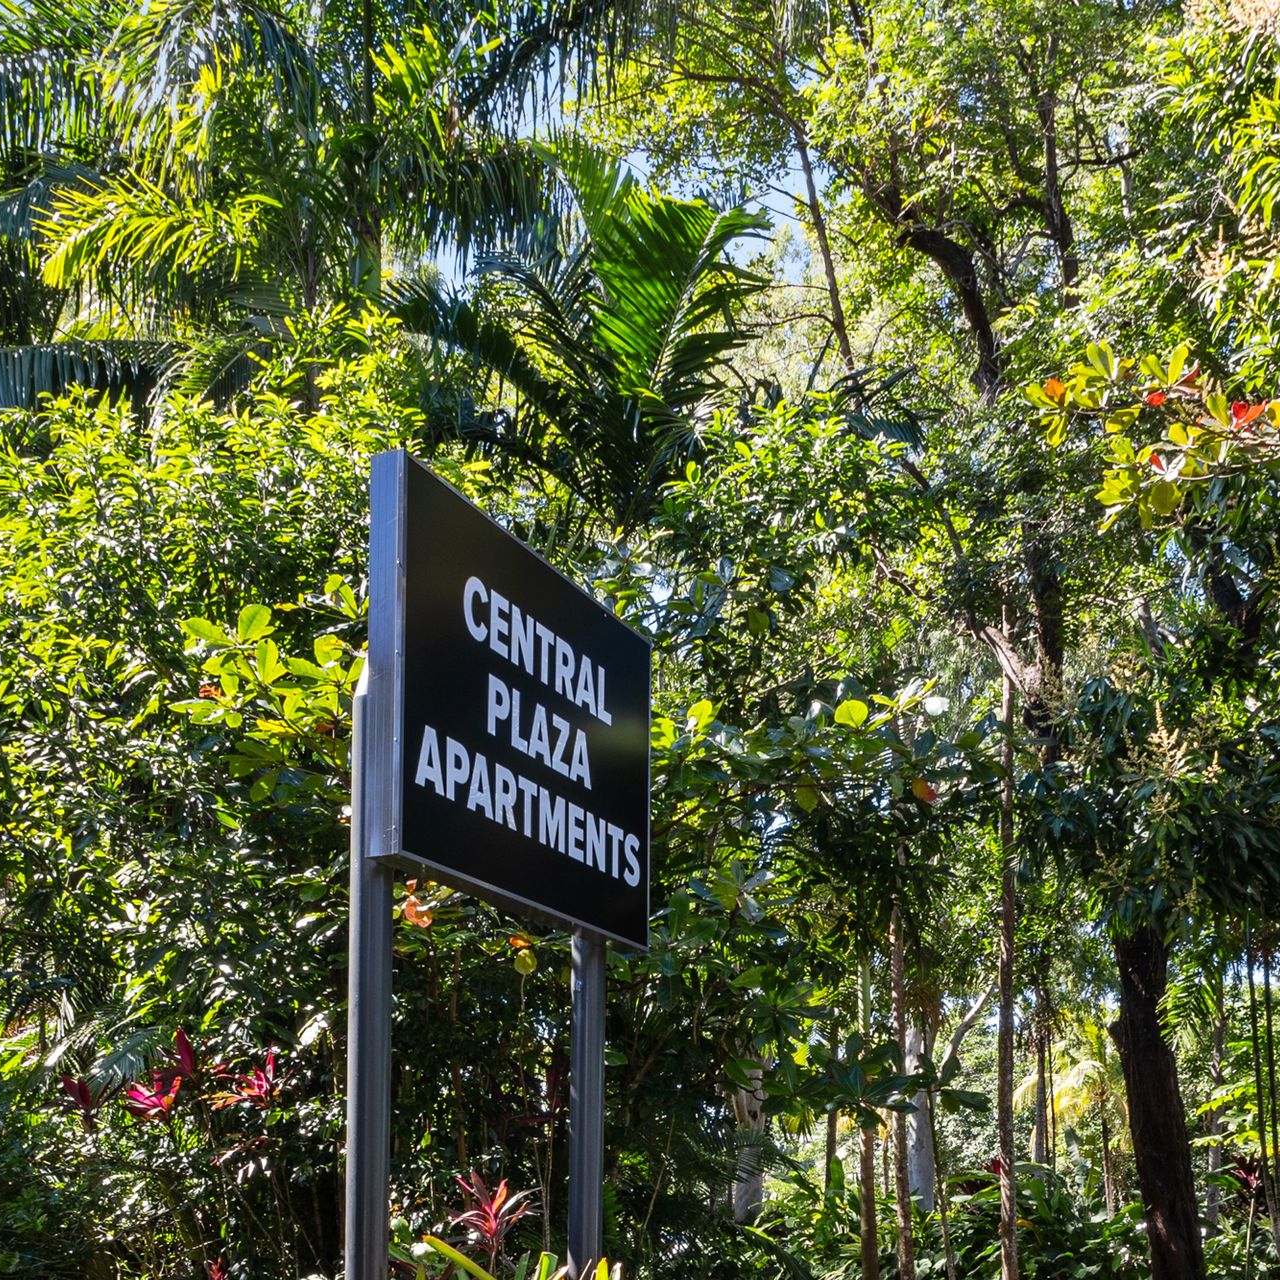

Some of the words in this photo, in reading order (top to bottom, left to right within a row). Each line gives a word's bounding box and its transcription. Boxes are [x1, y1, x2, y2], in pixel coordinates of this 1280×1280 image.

[462, 576, 612, 727] CENTRAL
[415, 725, 641, 888] APARTMENTS
[486, 673, 592, 790] PLAZA
